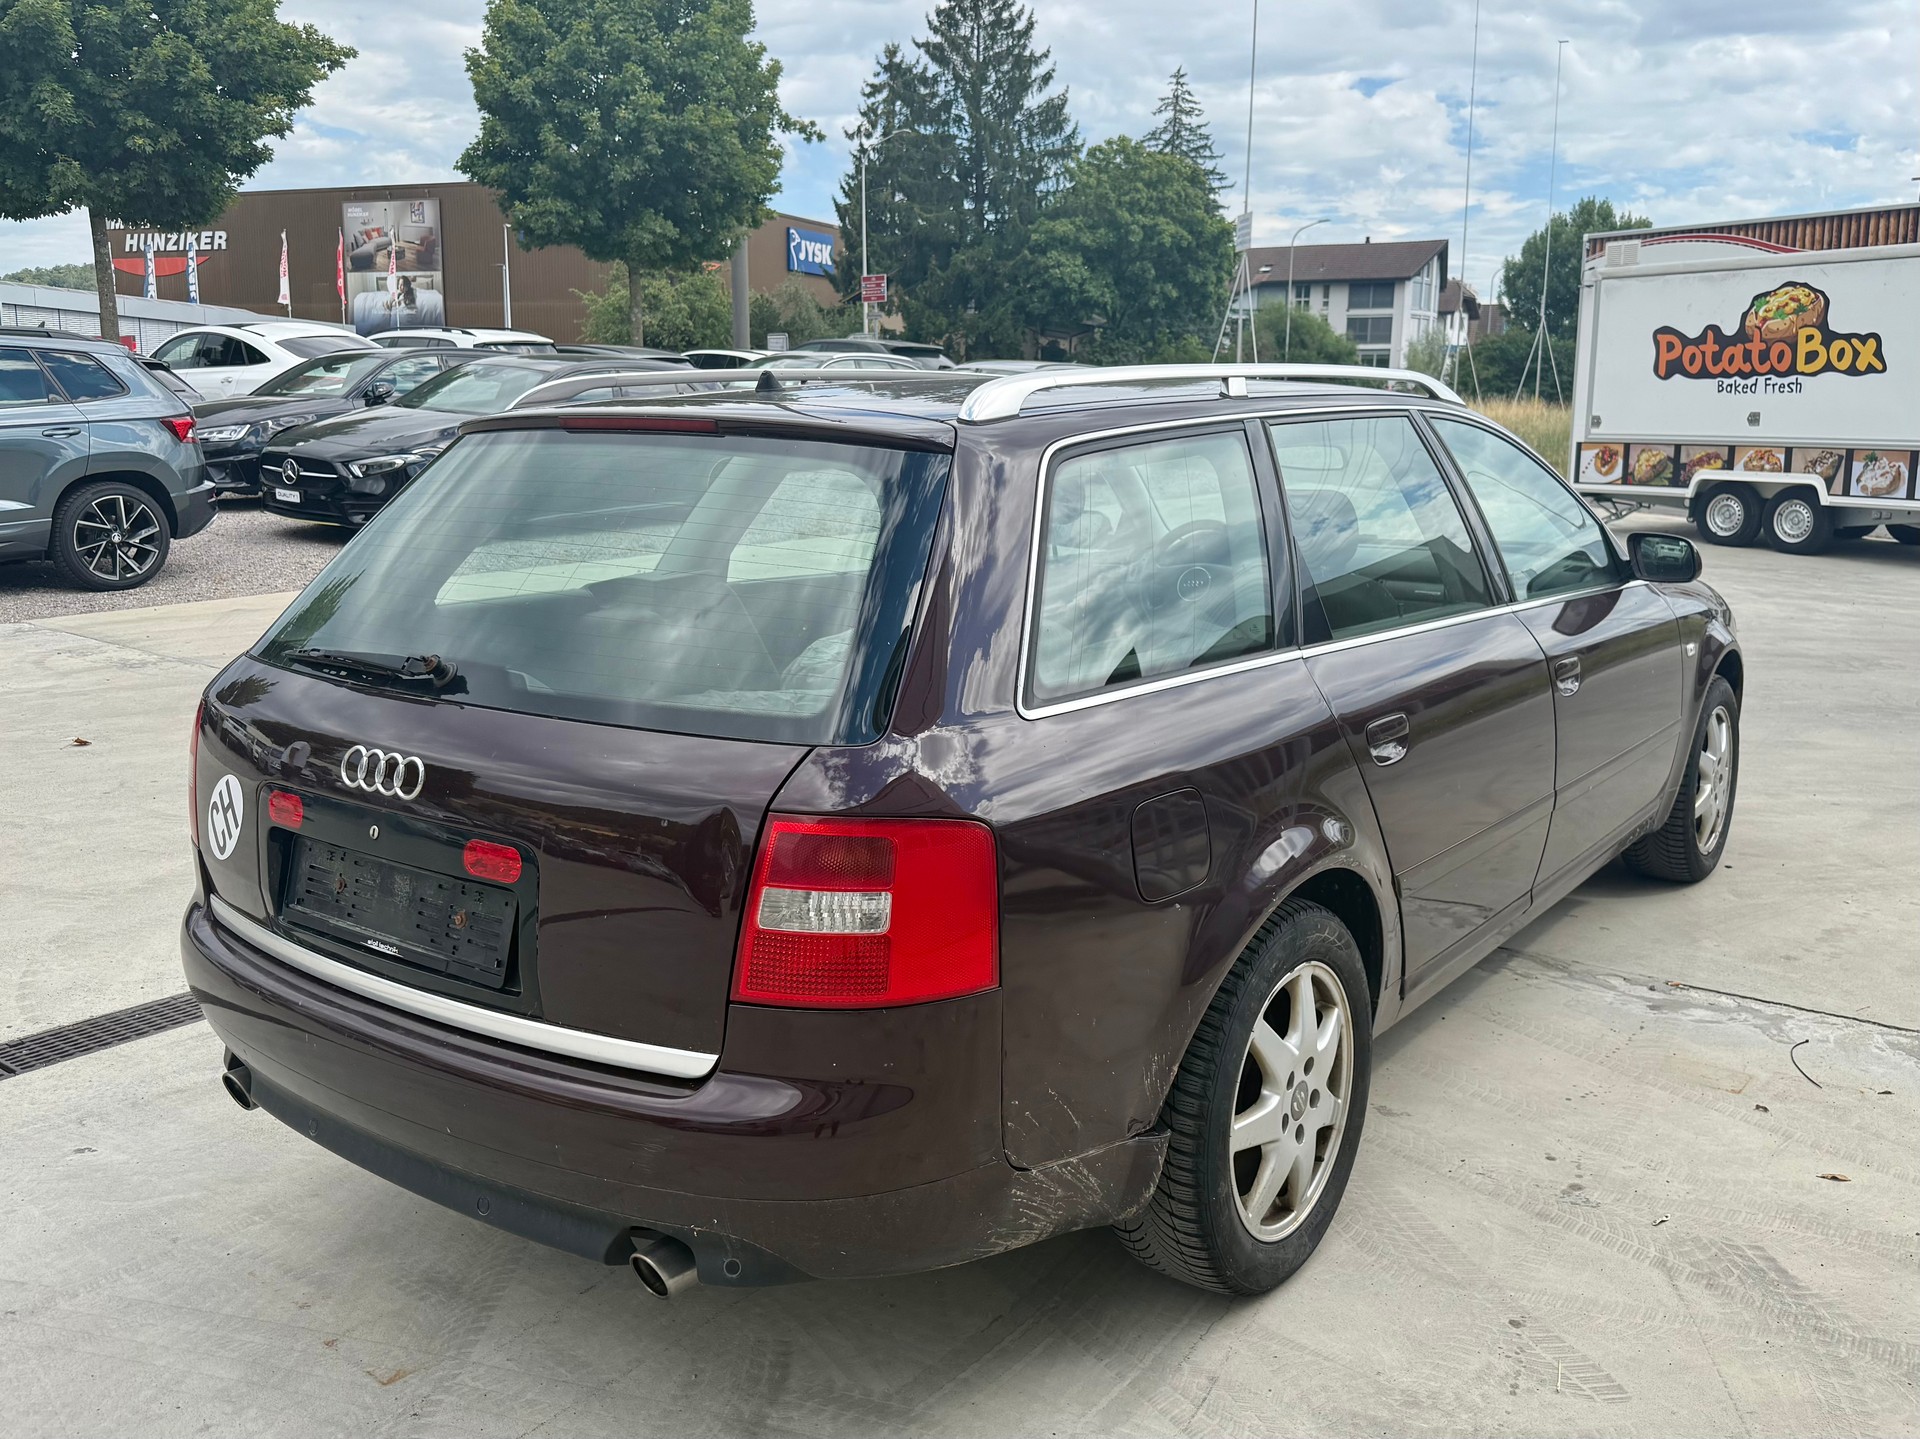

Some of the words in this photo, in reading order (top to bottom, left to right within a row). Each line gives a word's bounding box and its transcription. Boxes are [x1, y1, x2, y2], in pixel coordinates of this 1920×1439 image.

[125, 231, 228, 252] HUNZIKER
[799, 239, 832, 266] JYSK
[1717, 378, 1758, 395] Baked
[1764, 377, 1803, 394] Fresh
[210, 778, 239, 855] CH
